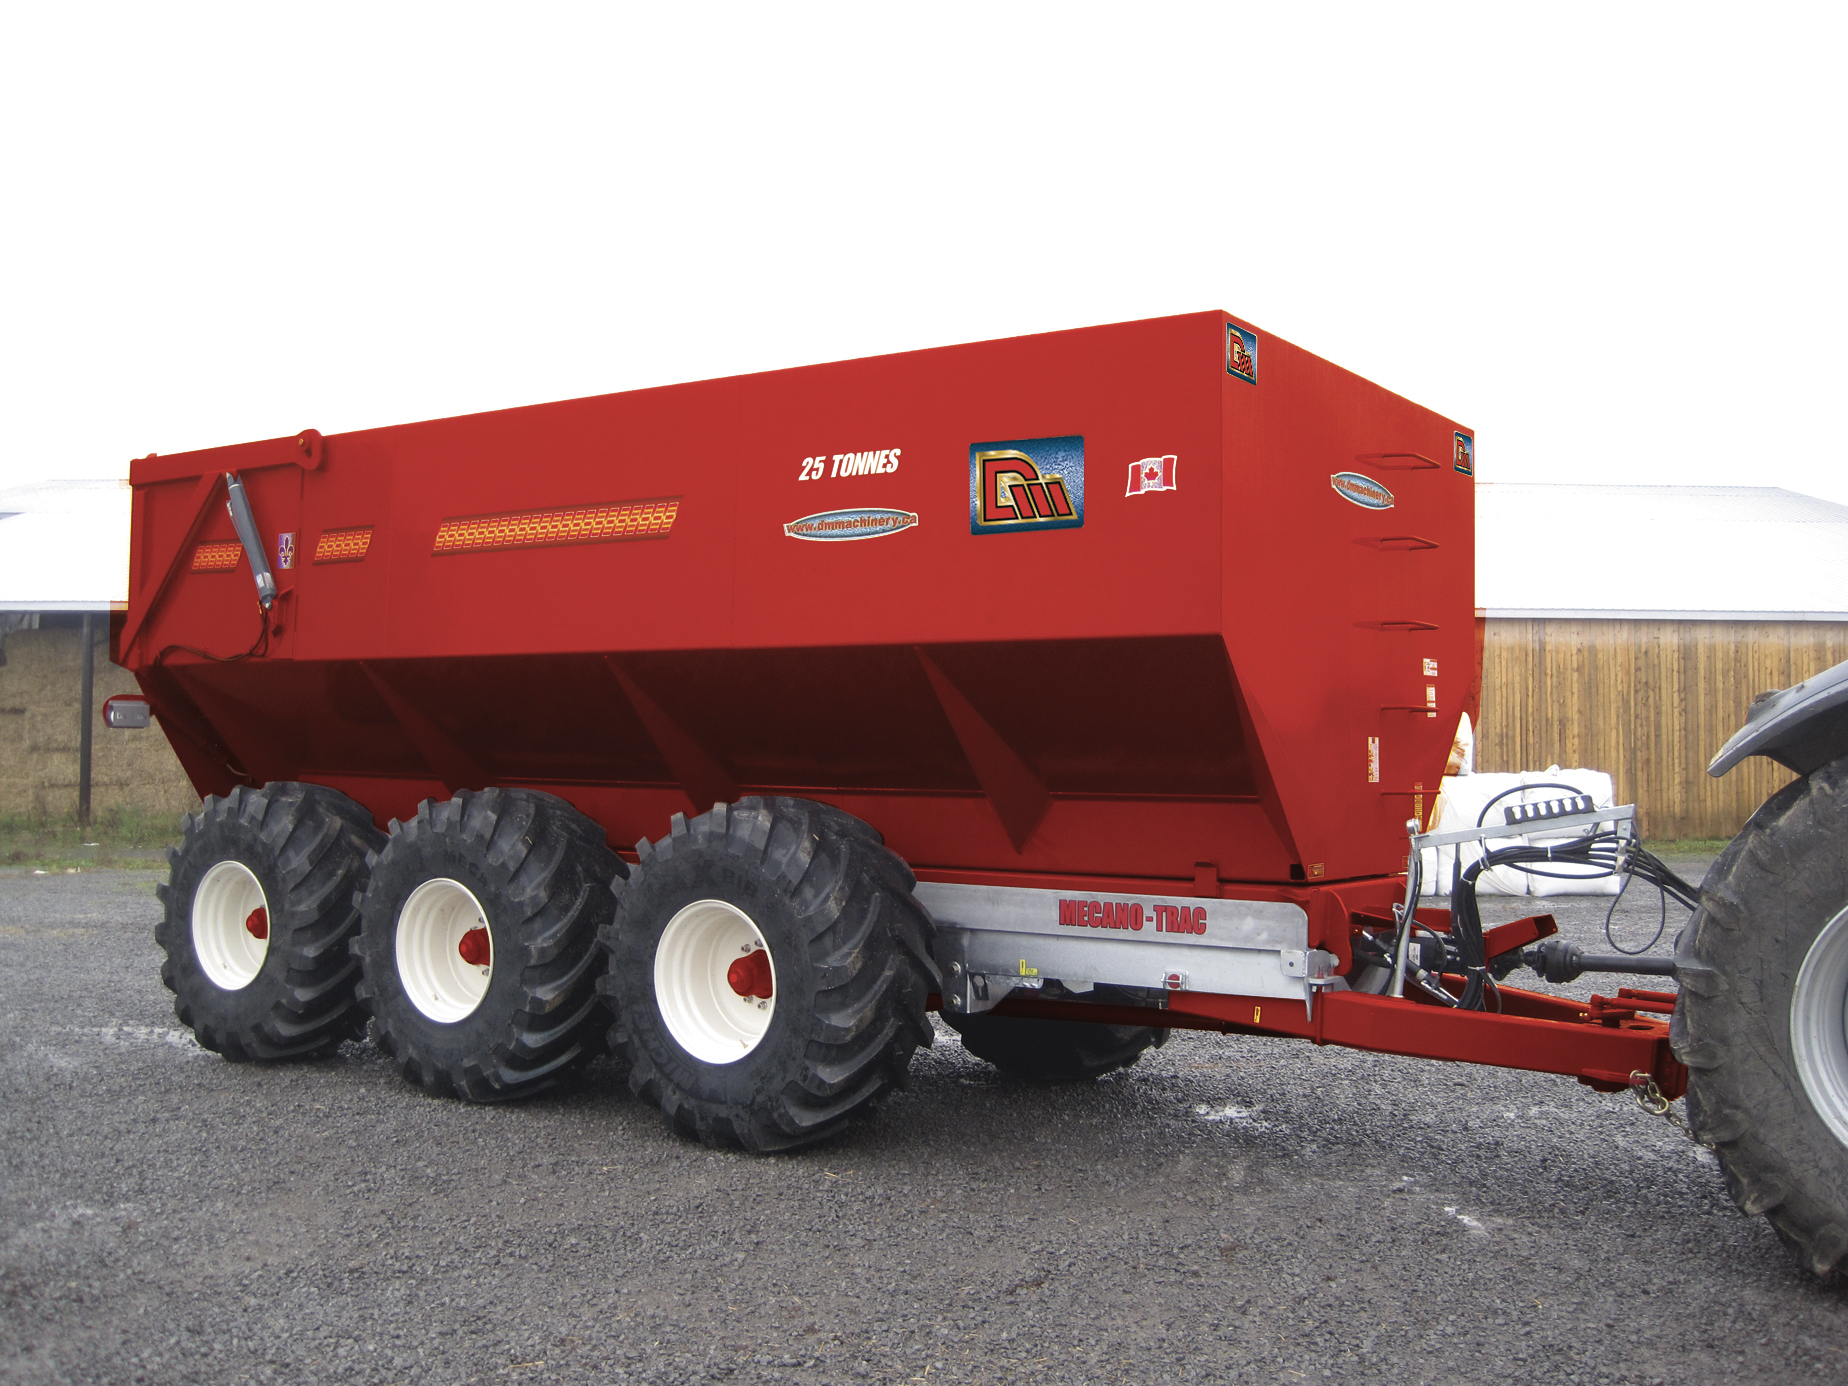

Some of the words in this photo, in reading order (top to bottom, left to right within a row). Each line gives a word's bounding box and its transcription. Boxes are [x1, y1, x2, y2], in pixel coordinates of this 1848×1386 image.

[798, 455, 827, 481] 25
[830, 448, 902, 478] TONNES
[785, 514, 917, 534] www.dmmachinery.ca
